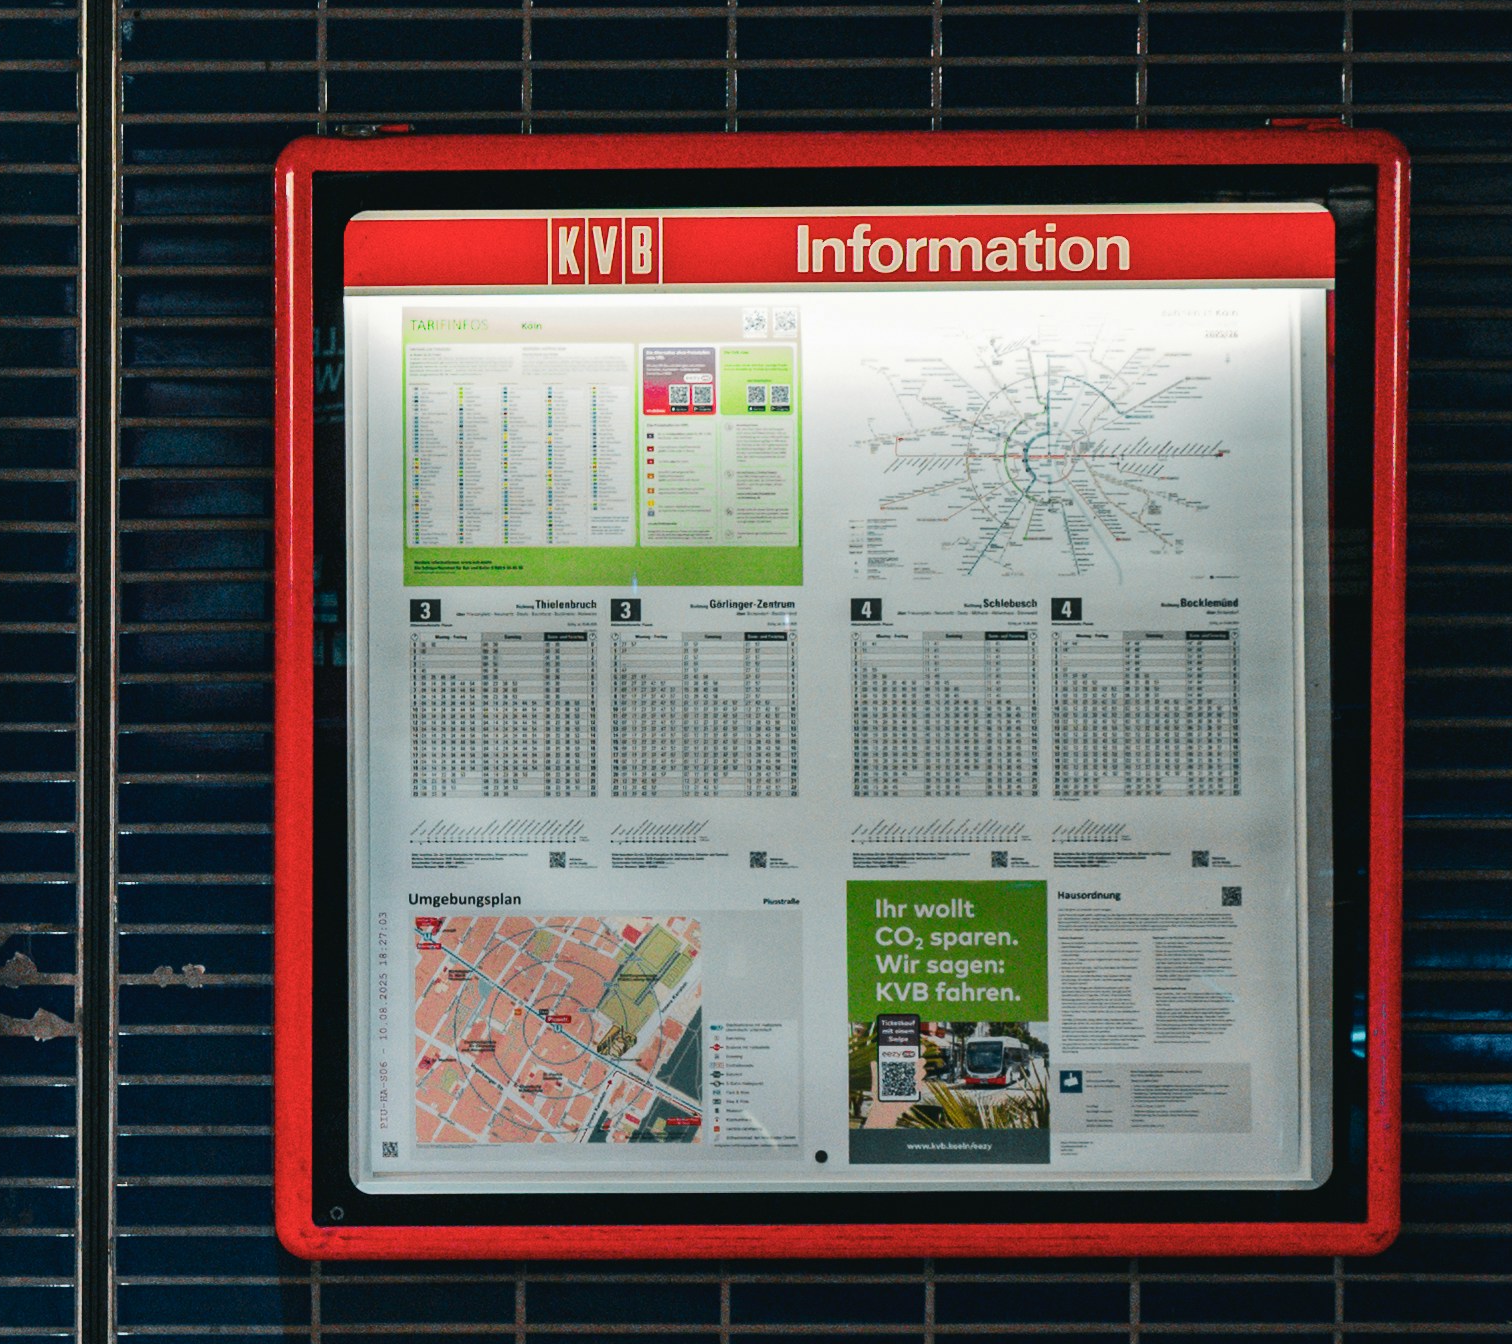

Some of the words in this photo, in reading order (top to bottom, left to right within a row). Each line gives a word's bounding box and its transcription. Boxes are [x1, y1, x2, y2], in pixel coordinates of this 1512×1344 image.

[556, 225, 654, 276] KVB
[795, 223, 1132, 274] Information
[409, 319, 489, 331] TARIFINFOS
[420, 602, 431, 620] 3
[535, 599, 597, 609] Thielenbruch
[620, 601, 631, 619] 3
[709, 599, 796, 610] Görlinger-Zentrum
[861, 601, 872, 618] 4
[983, 598, 1038, 608] Schlebusch
[1061, 601, 1072, 618] 4
[1180, 597, 1239, 608] Bocklemünd
[408, 893, 522, 908] Umgebungsplan
[1057, 890, 1122, 901] Hausordnung
[875, 898, 907, 918] Ihr
[914, 898, 975, 918] wollt
[378, 912, 388, 966] 18:27:03
[930, 930, 1019, 951] sparen.
[875, 954, 920, 974] Wir
[926, 958, 1005, 978] sagen:
[876, 982, 929, 1002] KVB
[935, 981, 1021, 1002] fahren.
[379, 973, 388, 1041] 10.08.2025
[881, 1019, 916, 1027] Ticketkauf
[906, 1142, 993, 1152] www.kvb.koeln/eezy
